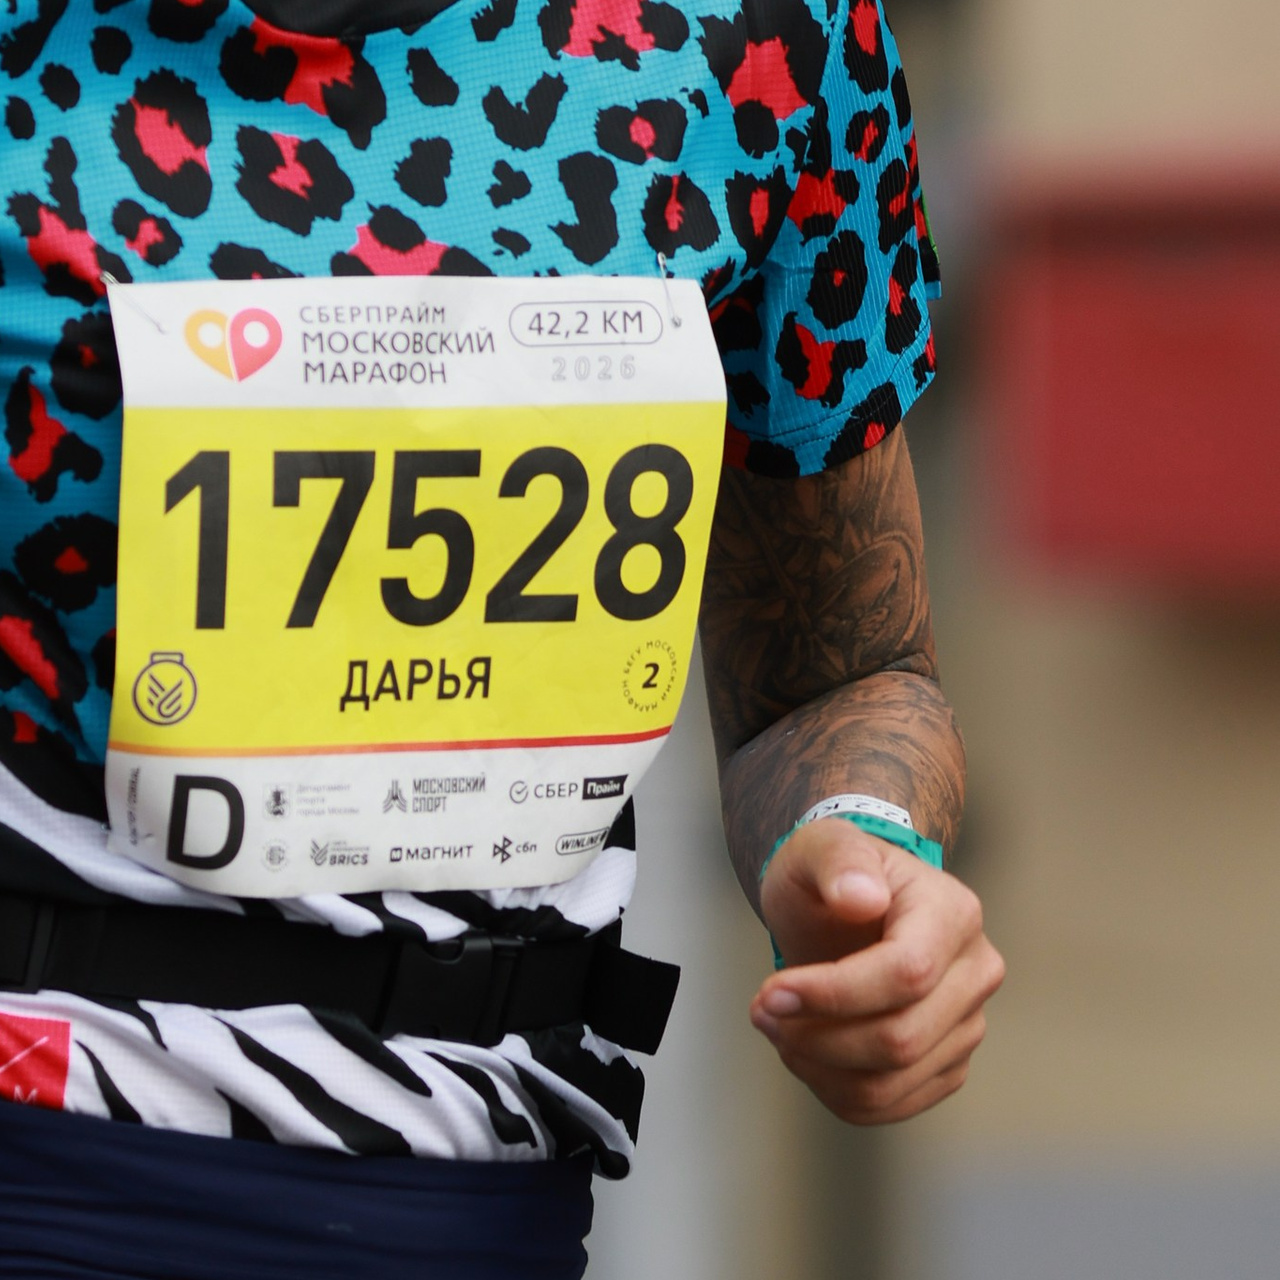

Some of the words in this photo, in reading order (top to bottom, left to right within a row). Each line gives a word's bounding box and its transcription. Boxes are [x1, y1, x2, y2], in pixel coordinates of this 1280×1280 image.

[300, 302, 446, 324] СБЕРПРАЙМ
[528, 310, 589, 339] 42,2
[603, 310, 643, 334] КМ
[302, 326, 496, 354] МОСКОВСКИЙ
[304, 361, 447, 384] МАРАФОН
[551, 355, 636, 382] 2026
[164, 443, 695, 630] 17528
[339, 656, 493, 712] ДАРЬЯ
[642, 662, 659, 689] 2
[413, 772, 487, 794] МОСКОВСКИЙ
[534, 782, 578, 799] СБЕР
[412, 796, 448, 813] СПОРТ
[165, 774, 245, 871] D
[329, 852, 369, 866] BRICS
[516, 841, 537, 854] сбп
